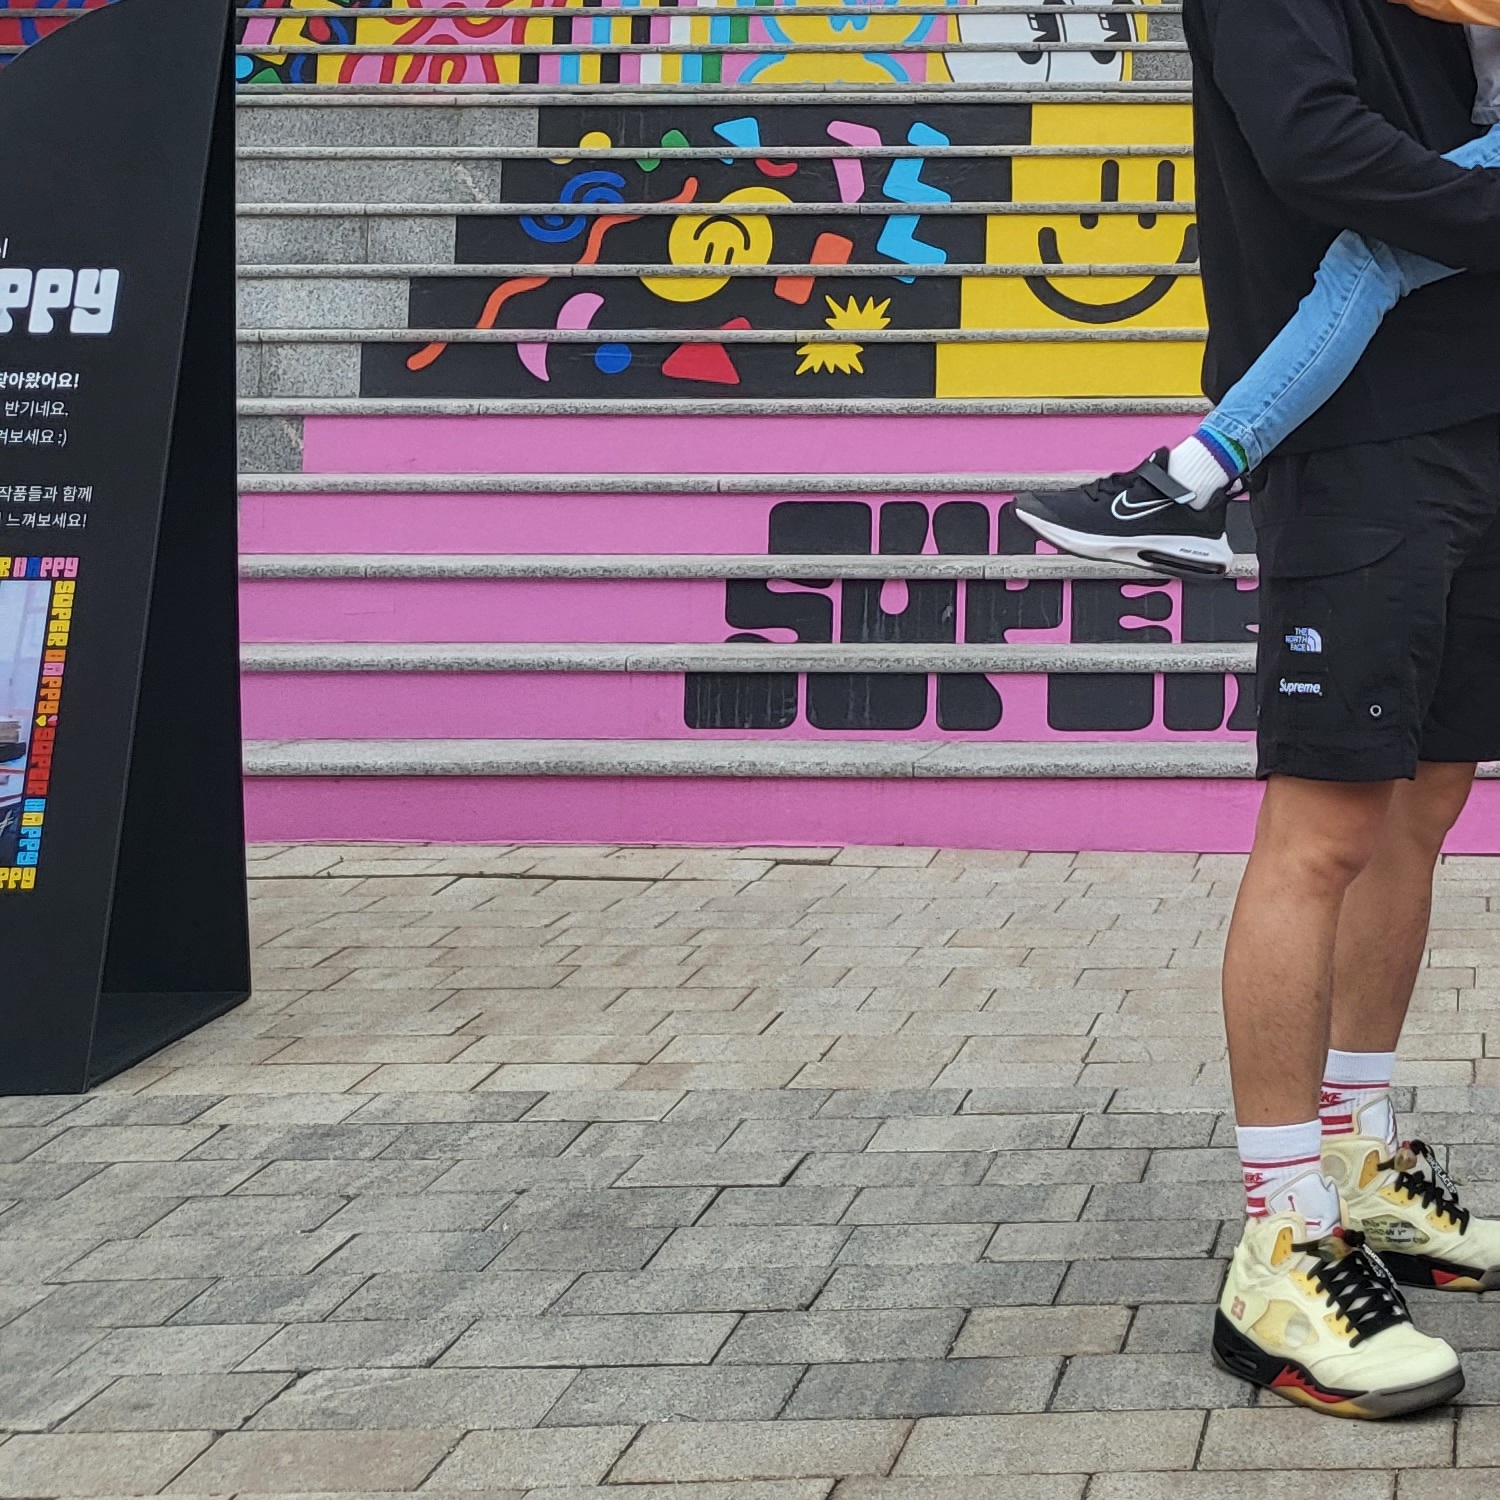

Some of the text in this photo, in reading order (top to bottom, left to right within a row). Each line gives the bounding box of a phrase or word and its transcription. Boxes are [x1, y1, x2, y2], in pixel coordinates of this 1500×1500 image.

[5, 400, 69, 418] 반기네요.
[63, 485, 93, 503] 함께
[5, 512, 87, 529] 느껴보세요!
[1279, 678, 1323, 697] Supreme
